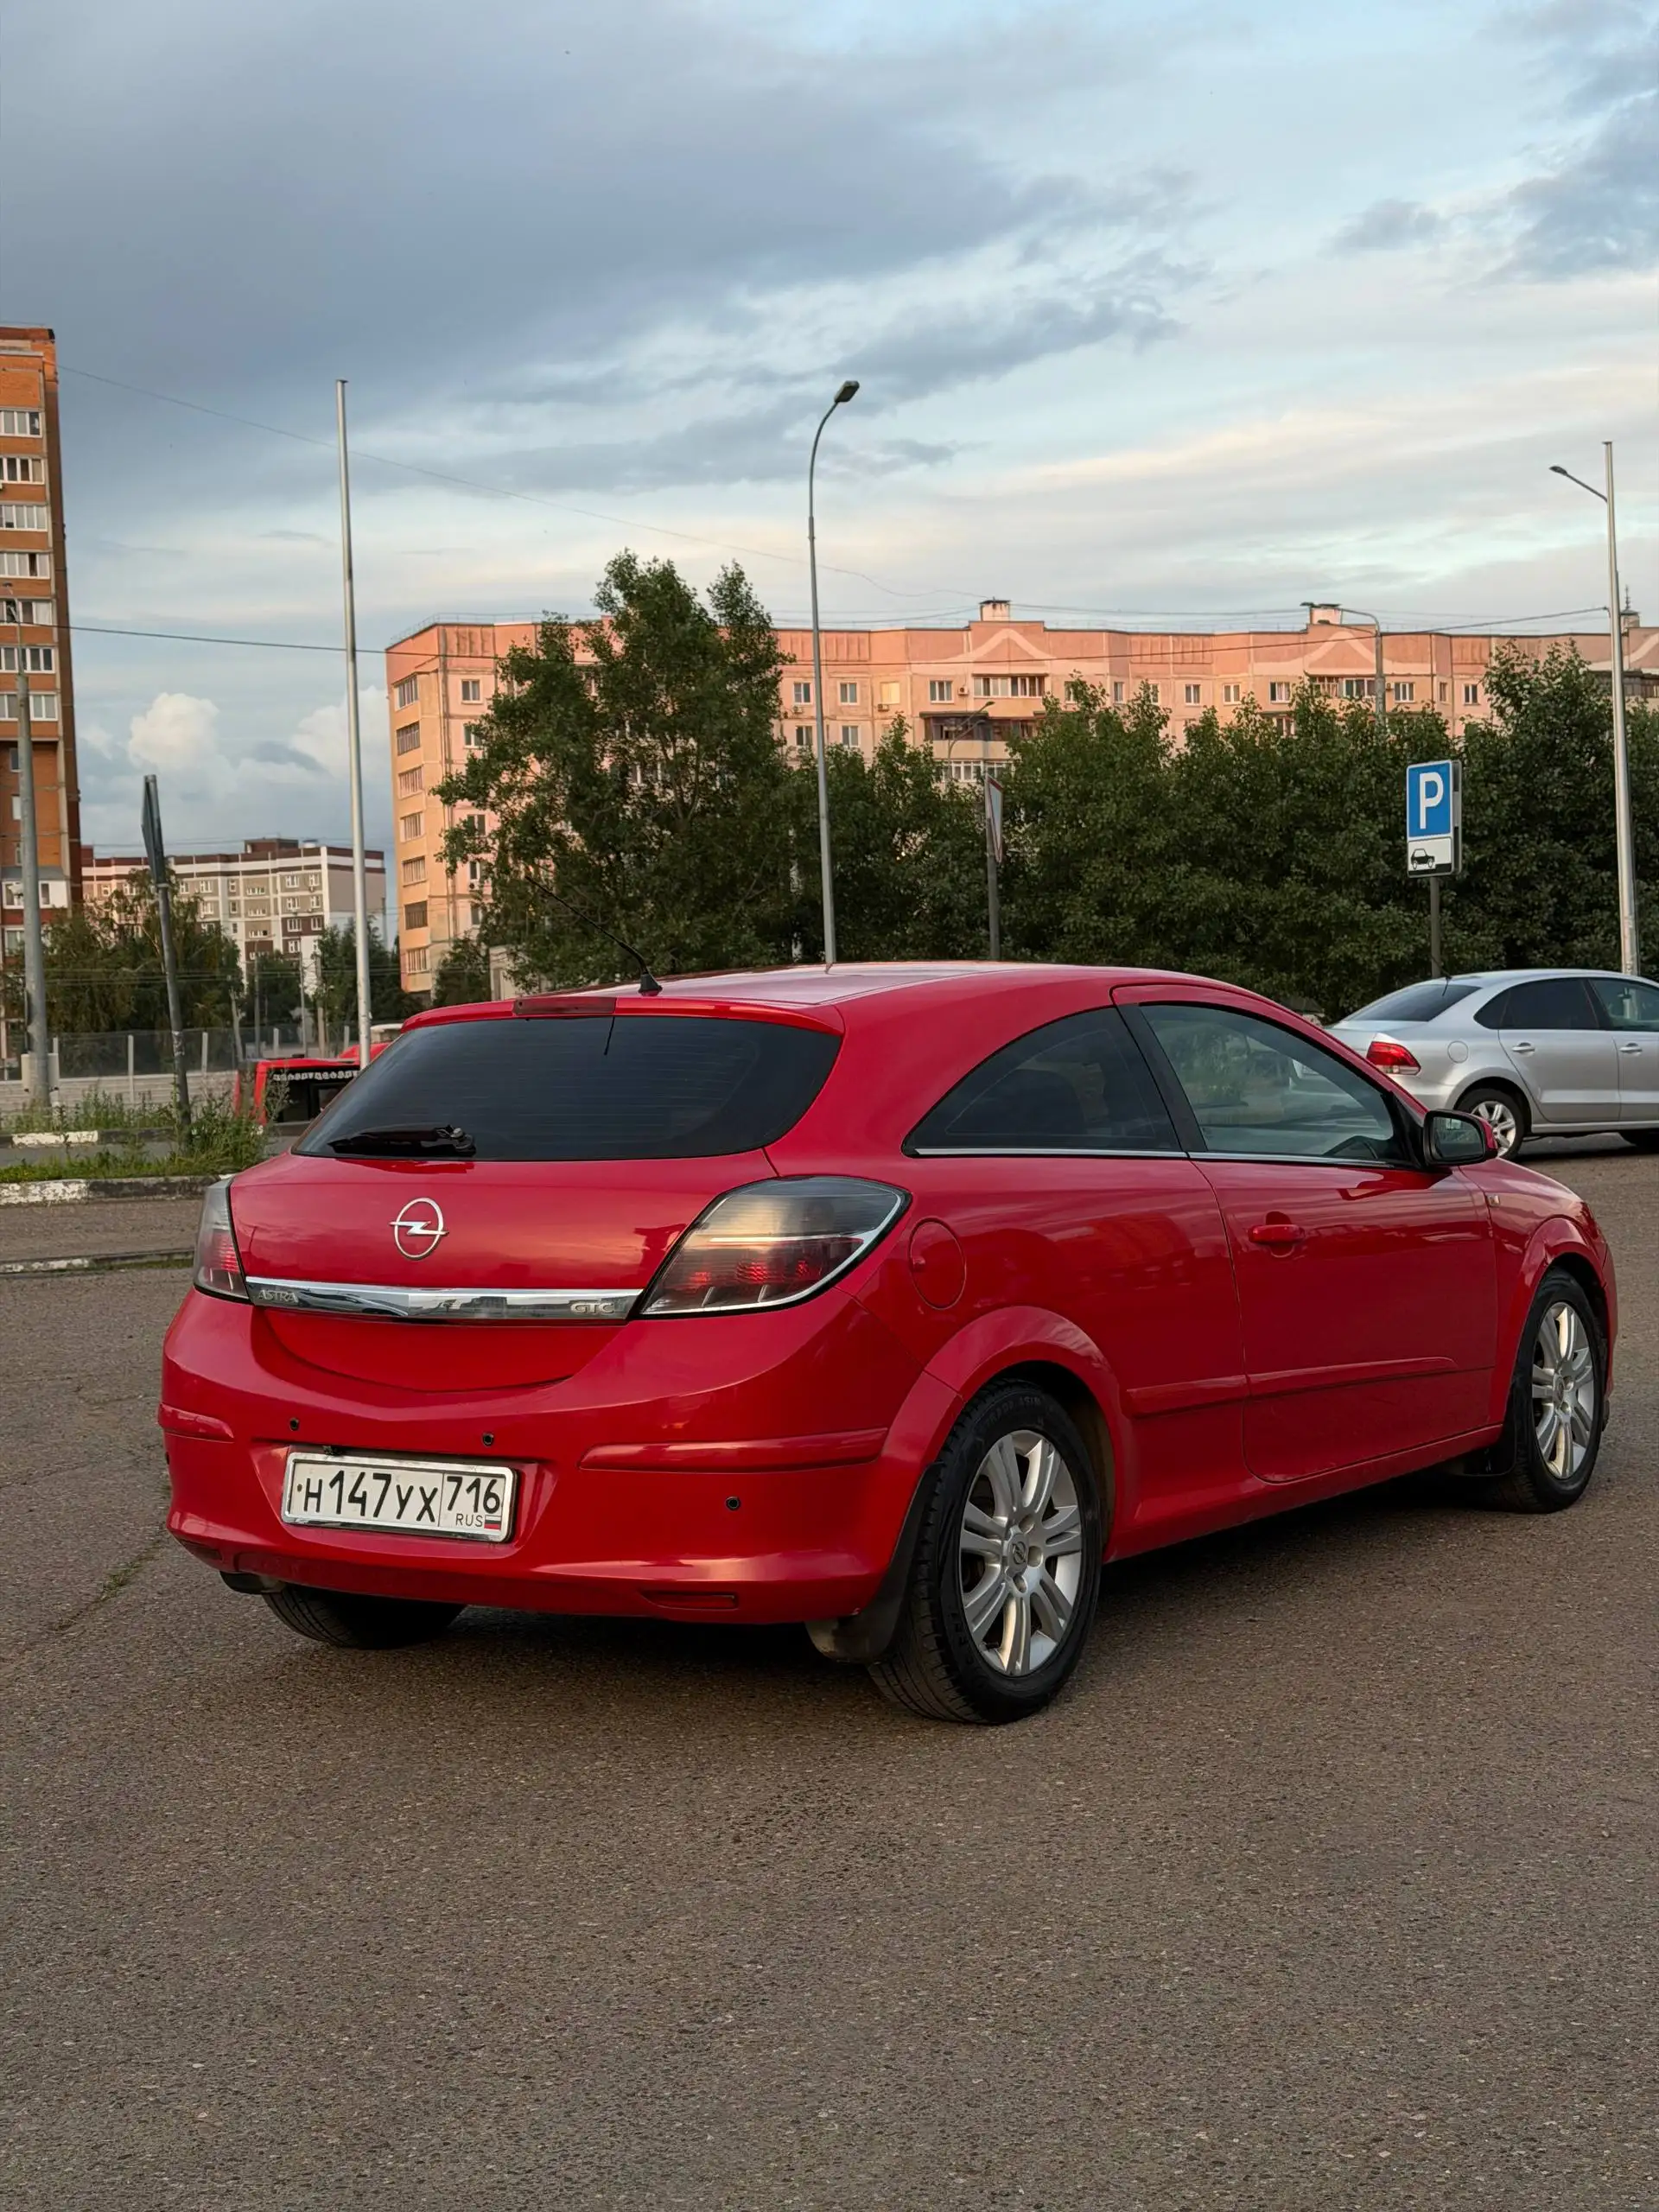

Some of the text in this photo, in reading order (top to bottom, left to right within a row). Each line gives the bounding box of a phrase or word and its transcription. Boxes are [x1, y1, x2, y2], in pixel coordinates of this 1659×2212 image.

[1420, 772, 1444, 830] P
[259, 1289, 299, 1304] ASTRA
[570, 1301, 615, 1314] GTC
[447, 1476, 501, 1514] 716
[455, 1513, 484, 1528] RUS
